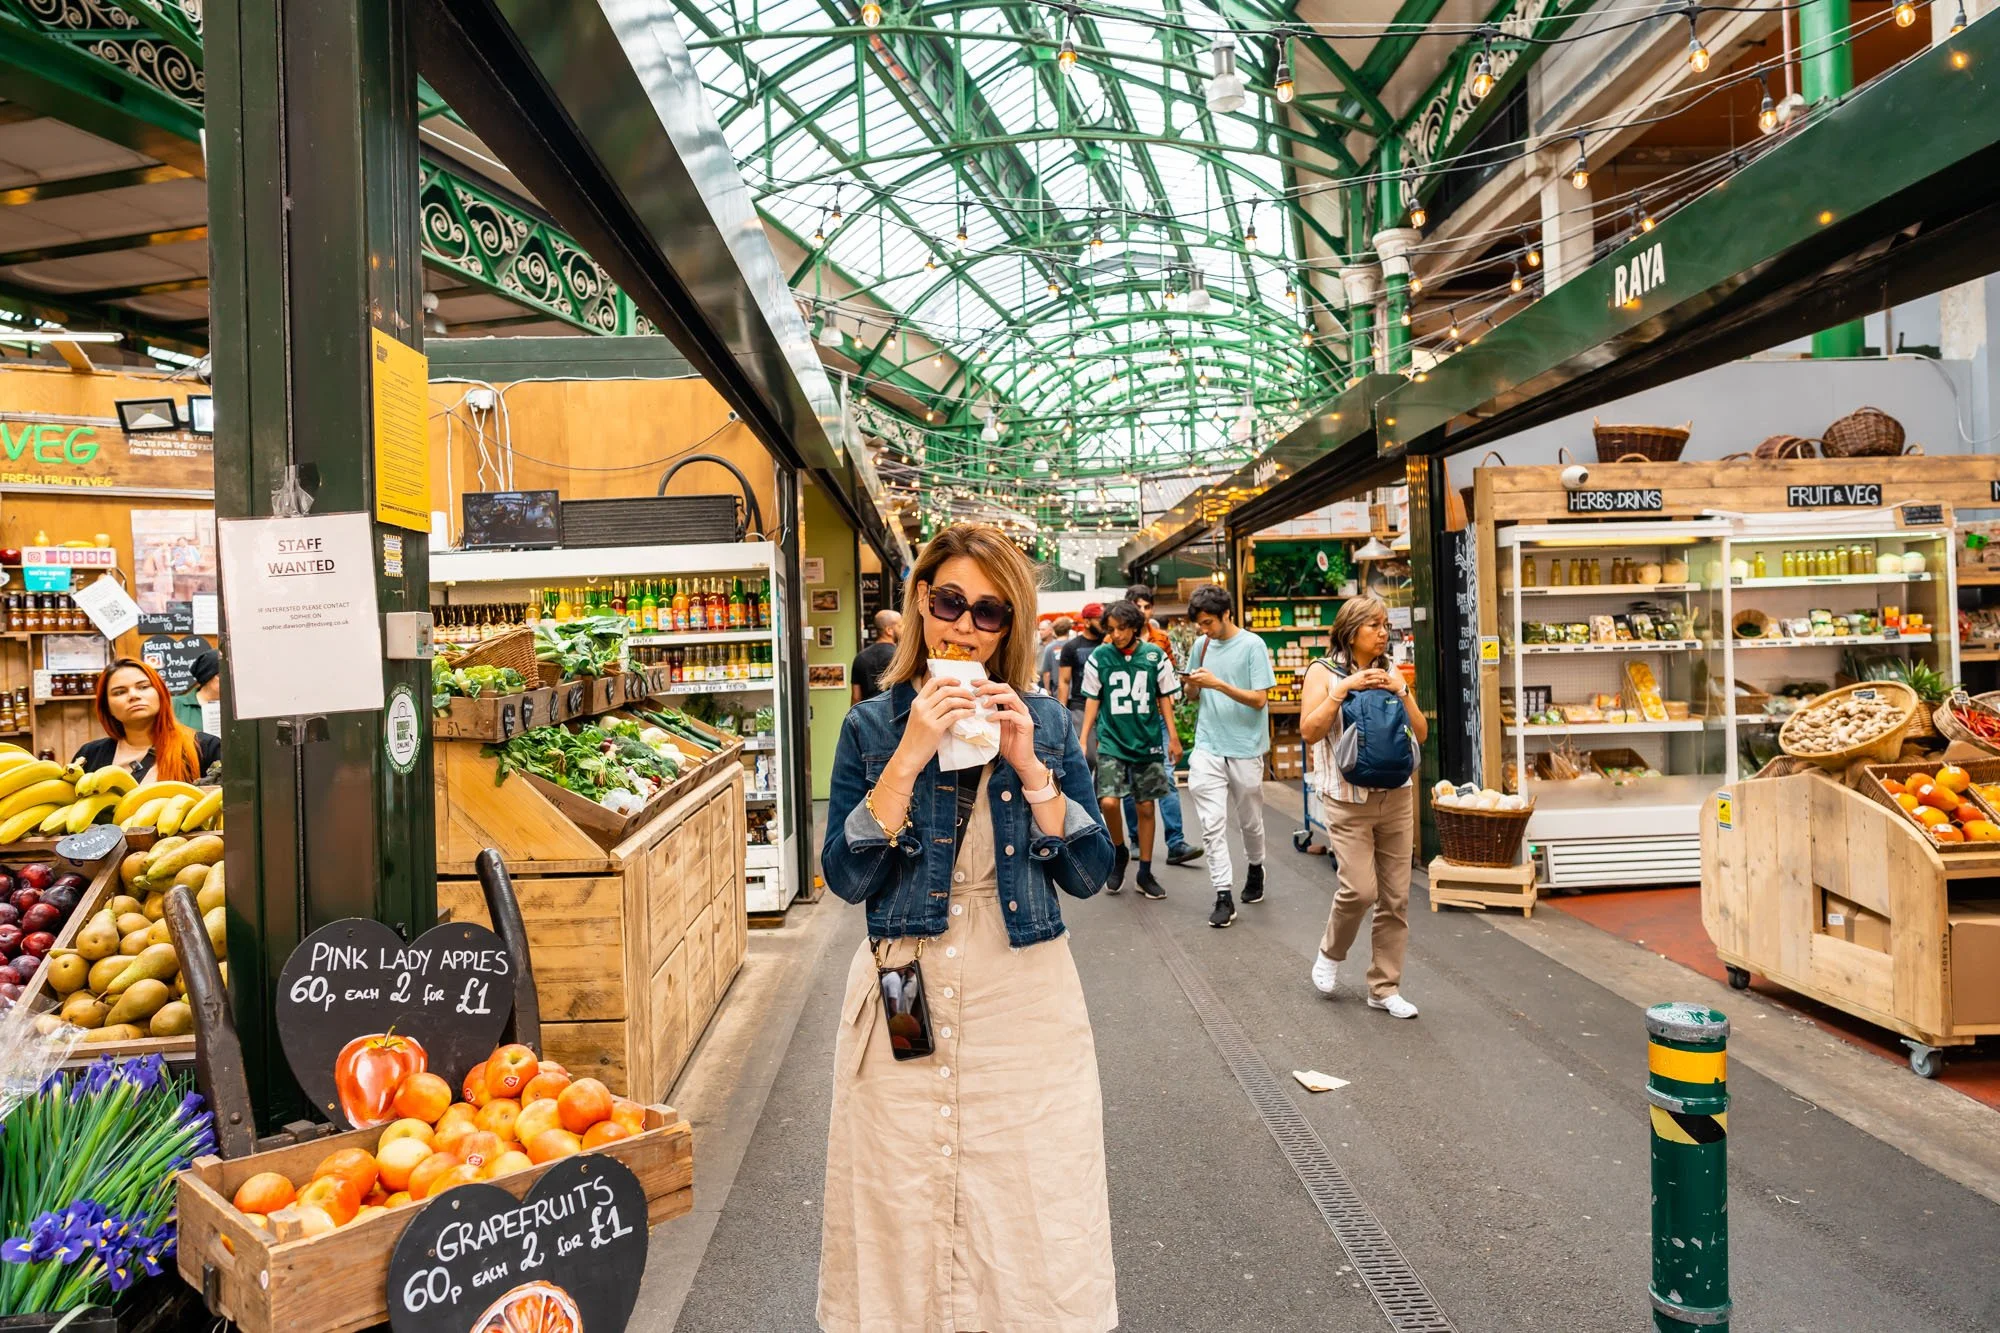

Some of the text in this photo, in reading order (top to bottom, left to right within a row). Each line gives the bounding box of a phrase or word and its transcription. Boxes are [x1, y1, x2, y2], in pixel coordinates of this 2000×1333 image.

[1614, 242, 1666, 308] RAYA
[0, 422, 99, 464] VEG
[1, 472, 41, 484] FRESH
[90, 476, 113, 487] VEG
[1569, 489, 1662, 511] HERBS DRINKS
[1789, 484, 1879, 506] FRUIT & VEG
[278, 537, 323, 553] STAFF
[267, 559, 336, 575] WANTED
[264, 604, 301, 614] INTERESTED
[302, 603, 322, 611] PLEASE
[323, 601, 351, 609] CONTACT
[290, 613, 311, 621] SOPHIE
[1109, 671, 1151, 715] 24
[71, 834, 106, 851] PLUM
[310, 942, 509, 976] PINK LADY APPLES
[290, 975, 337, 1012] 60p
[344, 988, 380, 1000] EACH
[389, 972, 411, 1003] 2
[455, 977, 491, 1015] £1
[436, 1175, 615, 1262] GRAPEFRUITS
[472, 1262, 509, 1288] EACH
[520, 1231, 545, 1272] 2
[588, 1205, 634, 1250] £1
